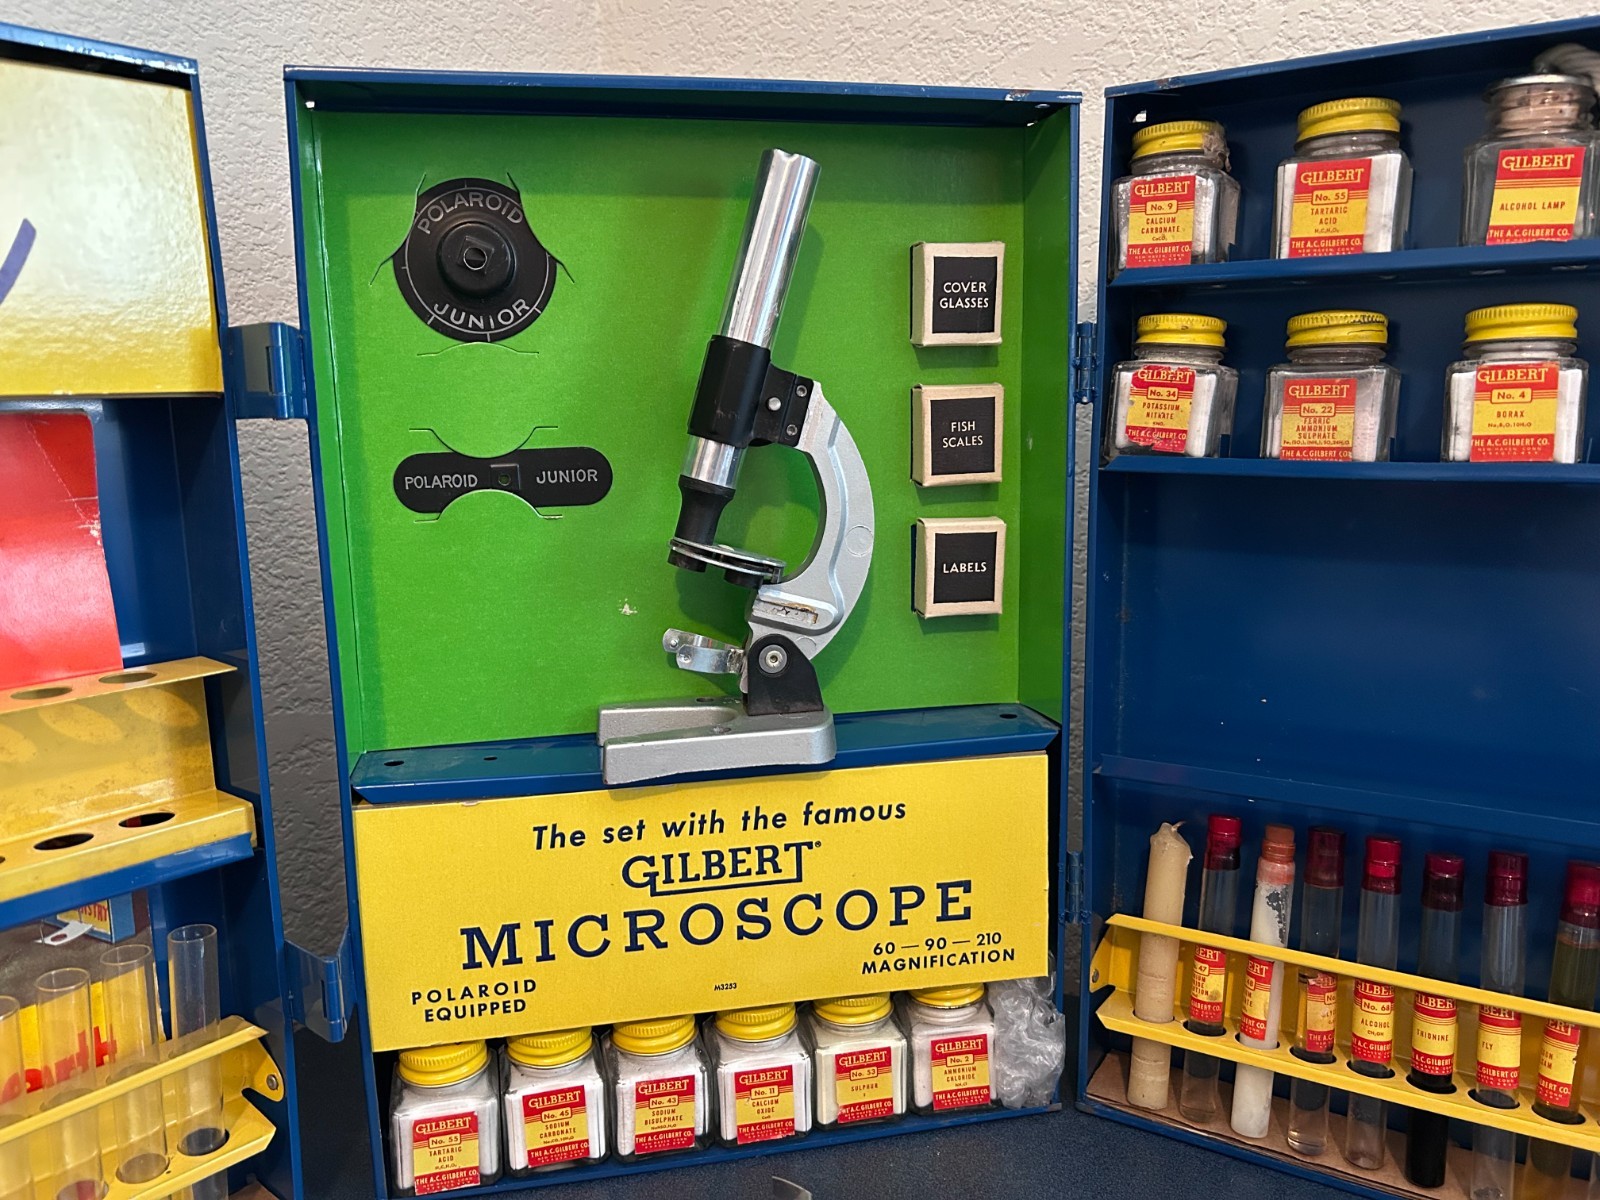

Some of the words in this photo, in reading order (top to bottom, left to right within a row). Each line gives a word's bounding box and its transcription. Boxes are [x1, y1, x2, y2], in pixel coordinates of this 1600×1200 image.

[1502, 154, 1575, 171] GILBERT
[1301, 168, 1364, 186] GILBERT
[1134, 181, 1190, 197] GILBERT
[1315, 193, 1330, 201] No.
[1334, 192, 1346, 200] 55
[1150, 203, 1164, 211] No.
[1167, 202, 1173, 210] 9
[1311, 206, 1347, 215] TARTARIC
[1500, 202, 1537, 210] ALCOHOL
[1541, 202, 1566, 210] LAMP
[417, 191, 524, 235] POLAROID
[1146, 217, 1176, 225] CALCIUM
[1319, 217, 1337, 225] ACID
[1141, 226, 1180, 234] CARBONATE
[1557, 228, 1570, 236] CO.
[943, 282, 987, 293] COVER
[939, 297, 989, 309] GLASSES
[433, 298, 530, 330] JUNIOR
[1138, 369, 1192, 384] GILBERT
[1477, 368, 1548, 384] GILBERT
[1150, 389, 1163, 397] No.
[1289, 385, 1350, 398] GILBERT
[1497, 392, 1515, 400] No.
[1519, 391, 1525, 399] 4
[1142, 402, 1180, 411] POTASSIUM
[1303, 406, 1318, 414] No.
[1146, 412, 1174, 420] NITRATE
[1496, 410, 1525, 418] BORAX
[951, 421, 976, 432] FISH
[942, 435, 984, 448] SCALES
[1537, 437, 1550, 445] CO.
[405, 473, 478, 490] POLAROID
[536, 469, 598, 485] JUNIOR
[943, 562, 987, 573] LABELS
[533, 823, 586, 850] The
[602, 819, 645, 844] set
[662, 809, 725, 837] with
[741, 806, 788, 832] the
[802, 801, 907, 826] famous
[459, 879, 974, 970] MICROSCOPE
[873, 942, 895, 956] 60
[925, 937, 947, 951] 90
[976, 932, 1002, 946] 210
[861, 948, 1015, 975] MAGNIFICATION
[411, 979, 536, 1005] POLAROID
[425, 999, 526, 1023] EQUIPPED
[1363, 1002, 1378, 1011] No.
[1381, 1003, 1390, 1011] 68
[1256, 1021, 1266, 1029] CO.
[1361, 1018, 1390, 1028] ALCOHOL
[1308, 1033, 1321, 1041] THE
[936, 1039, 983, 1054] GILBERT
[839, 1051, 887, 1067] GILBERT
[944, 1066, 976, 1075] AMMONIUM
[1481, 1067, 1508, 1077] GILBERT
[739, 1069, 788, 1085] GILBERT
[946, 1073, 975, 1082] CHLORIDE
[638, 1079, 690, 1095] GILBERT
[851, 1083, 878, 1091] SULPHUR
[1559, 1086, 1571, 1095] CO.
[528, 1090, 581, 1109] GILBERT
[751, 1098, 779, 1107] CALCIUM
[651, 1109, 676, 1117] SODIUM
[756, 1107, 775, 1115] OXIDE
[644, 1115, 683, 1125] BISULPHATE
[415, 1117, 471, 1134] GILBERT
[545, 1121, 570, 1130] SODIUM
[540, 1127, 576, 1139] CARBONATE
[431, 1138, 445, 1146] No.
[429, 1146, 462, 1157] TARTARIC
[438, 1155, 454, 1163] ACID
